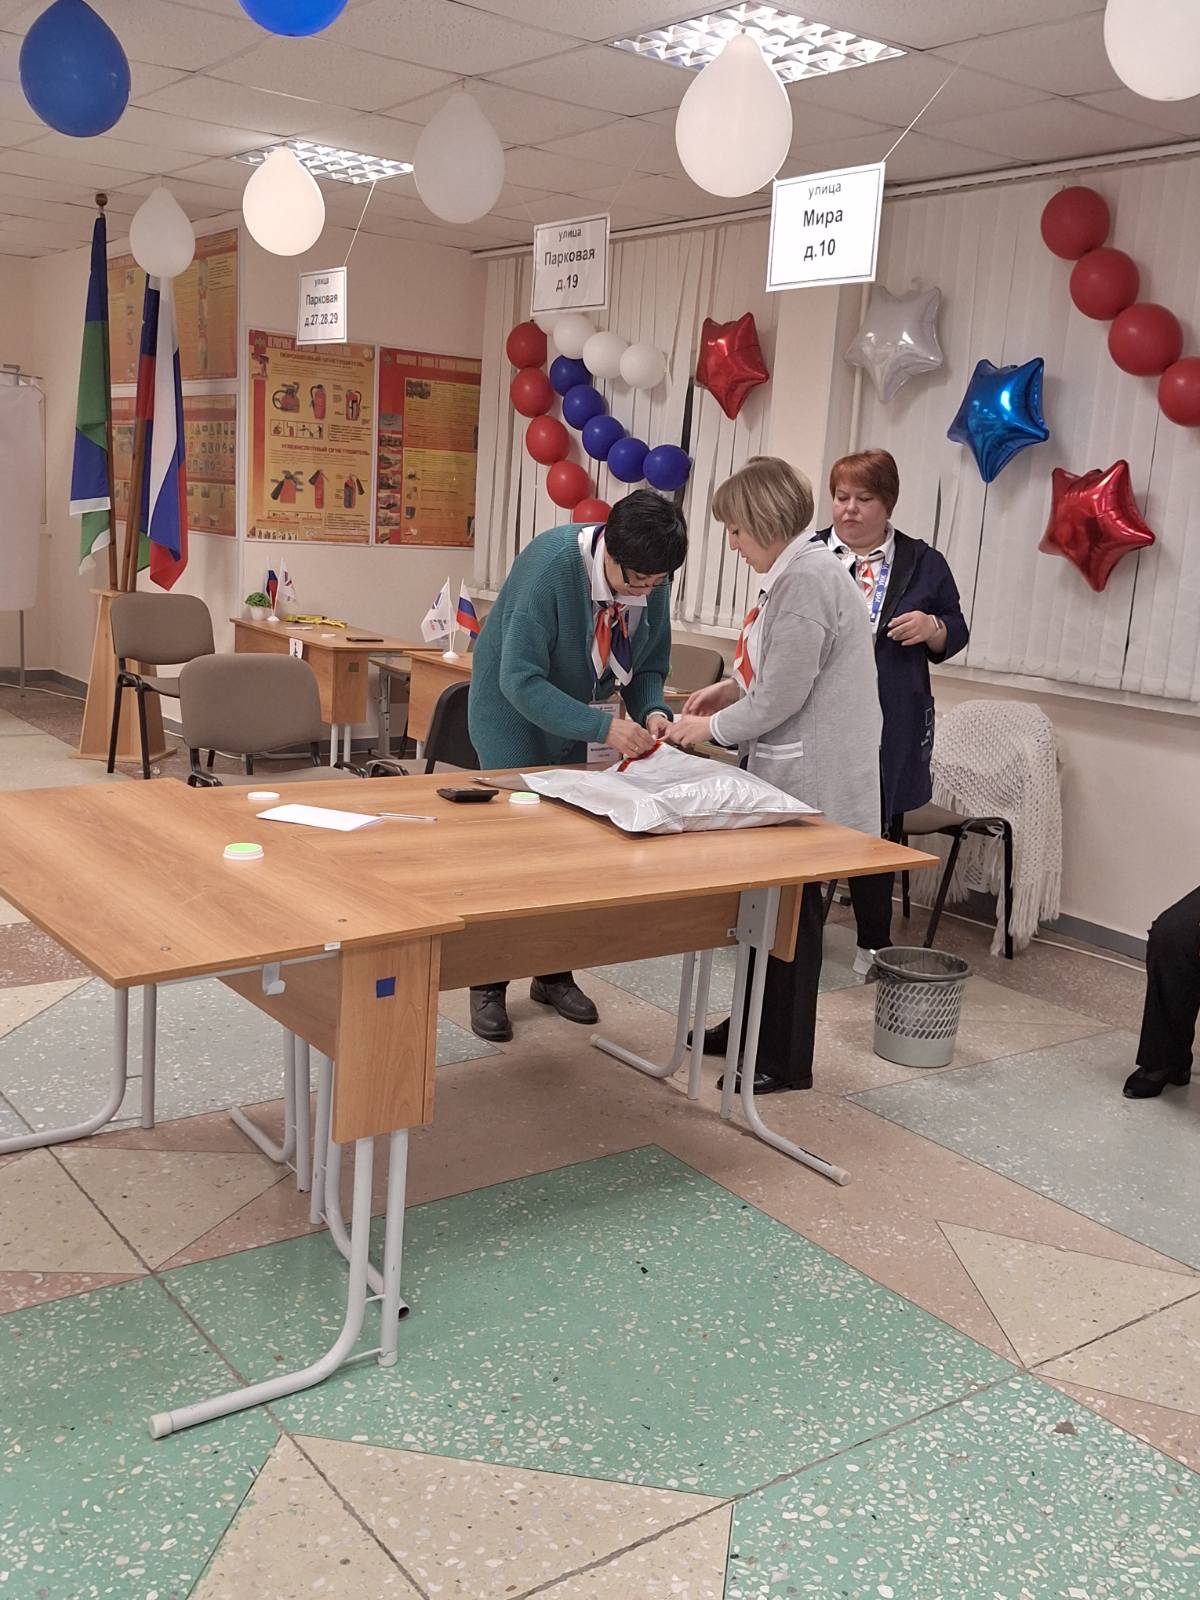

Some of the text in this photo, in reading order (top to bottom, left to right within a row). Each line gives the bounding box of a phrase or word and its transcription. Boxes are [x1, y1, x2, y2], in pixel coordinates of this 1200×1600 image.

[808, 183, 842, 200] улица
[803, 209, 843, 228] Мира
[558, 228, 581, 242] улица
[544, 248, 595, 267] Парковая
[803, 238, 836, 261] д.10
[556, 273, 579, 292] д.19
[305, 294, 338, 307] Парковая
